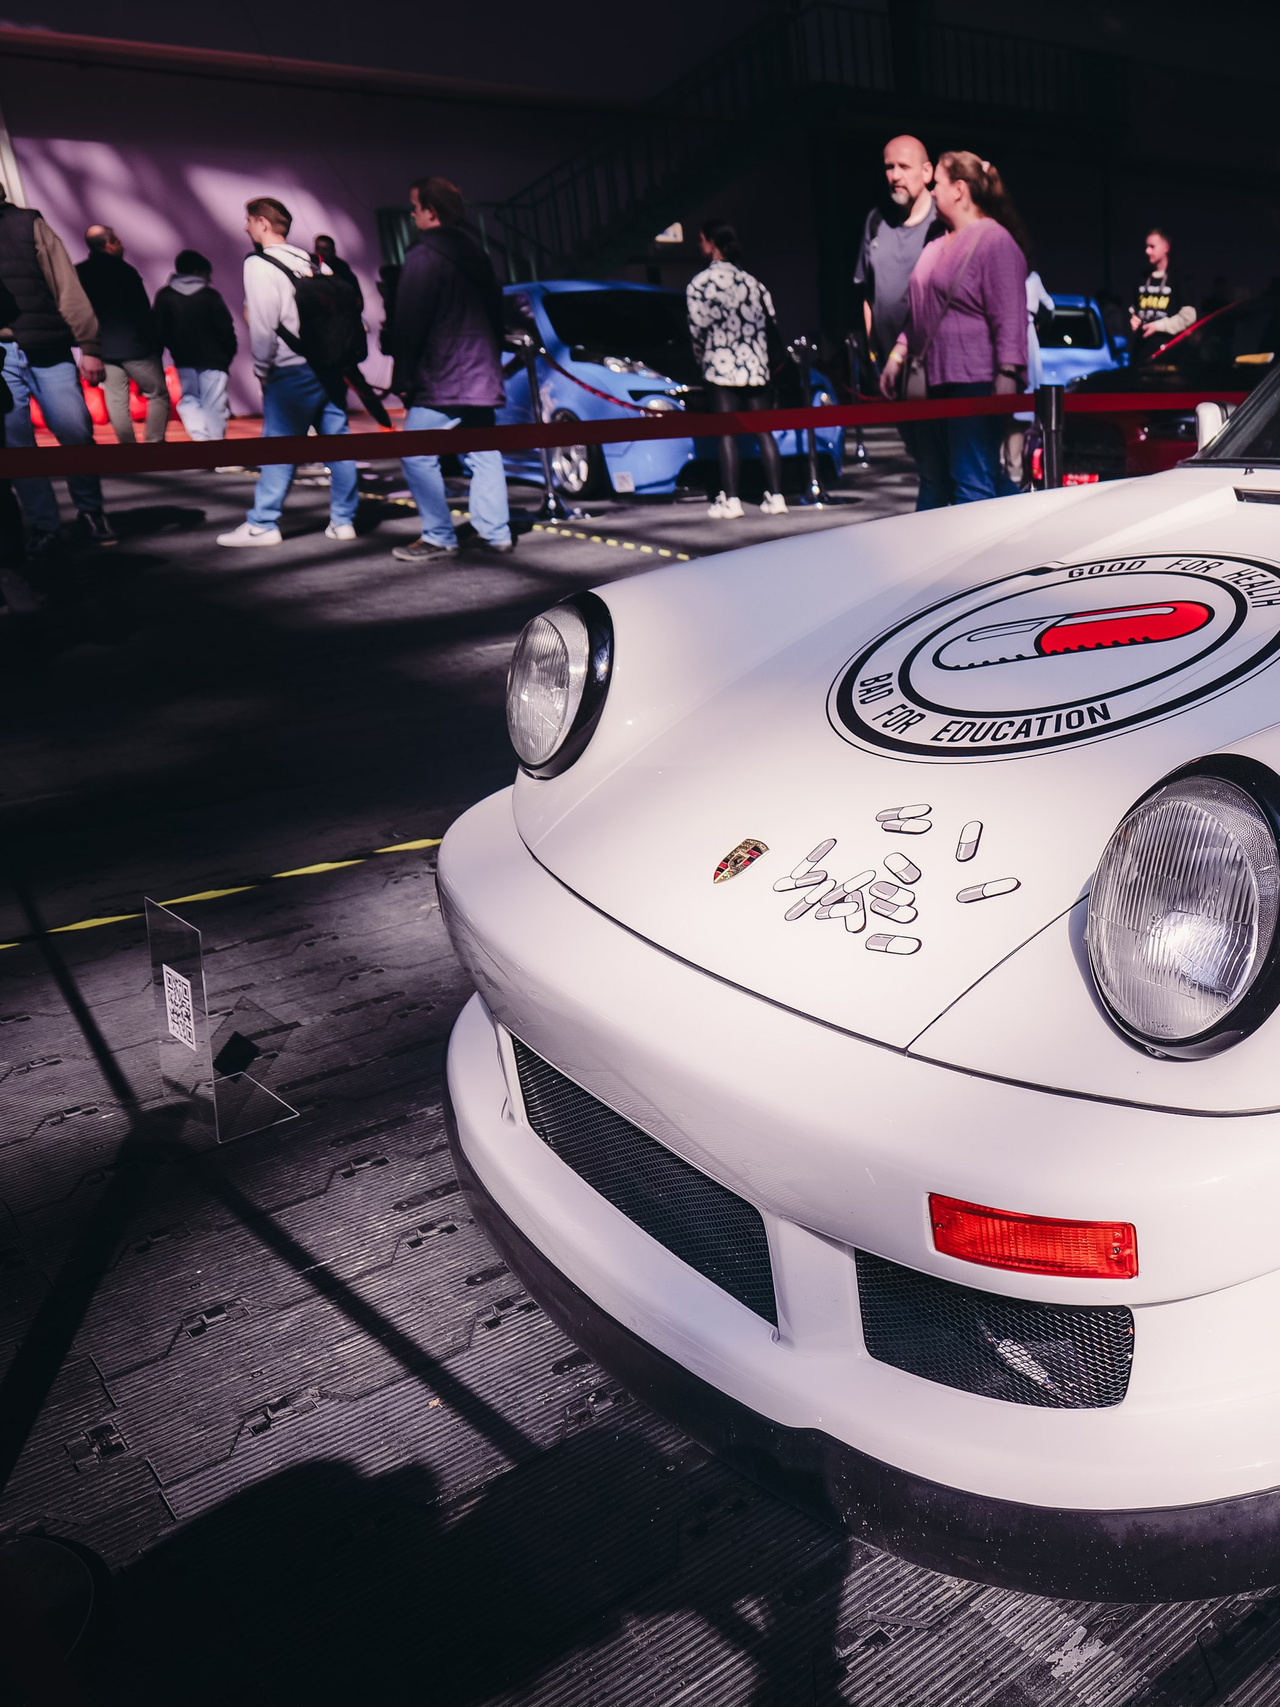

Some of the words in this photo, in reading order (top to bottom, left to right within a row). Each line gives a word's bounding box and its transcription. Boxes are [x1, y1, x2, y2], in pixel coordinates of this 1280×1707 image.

[1068, 560, 1146, 578] GOOD
[1165, 558, 1224, 573] FOR
[858, 672, 894, 705] BAD
[872, 703, 927, 734] FOR
[931, 702, 1112, 743] EDUCATION
